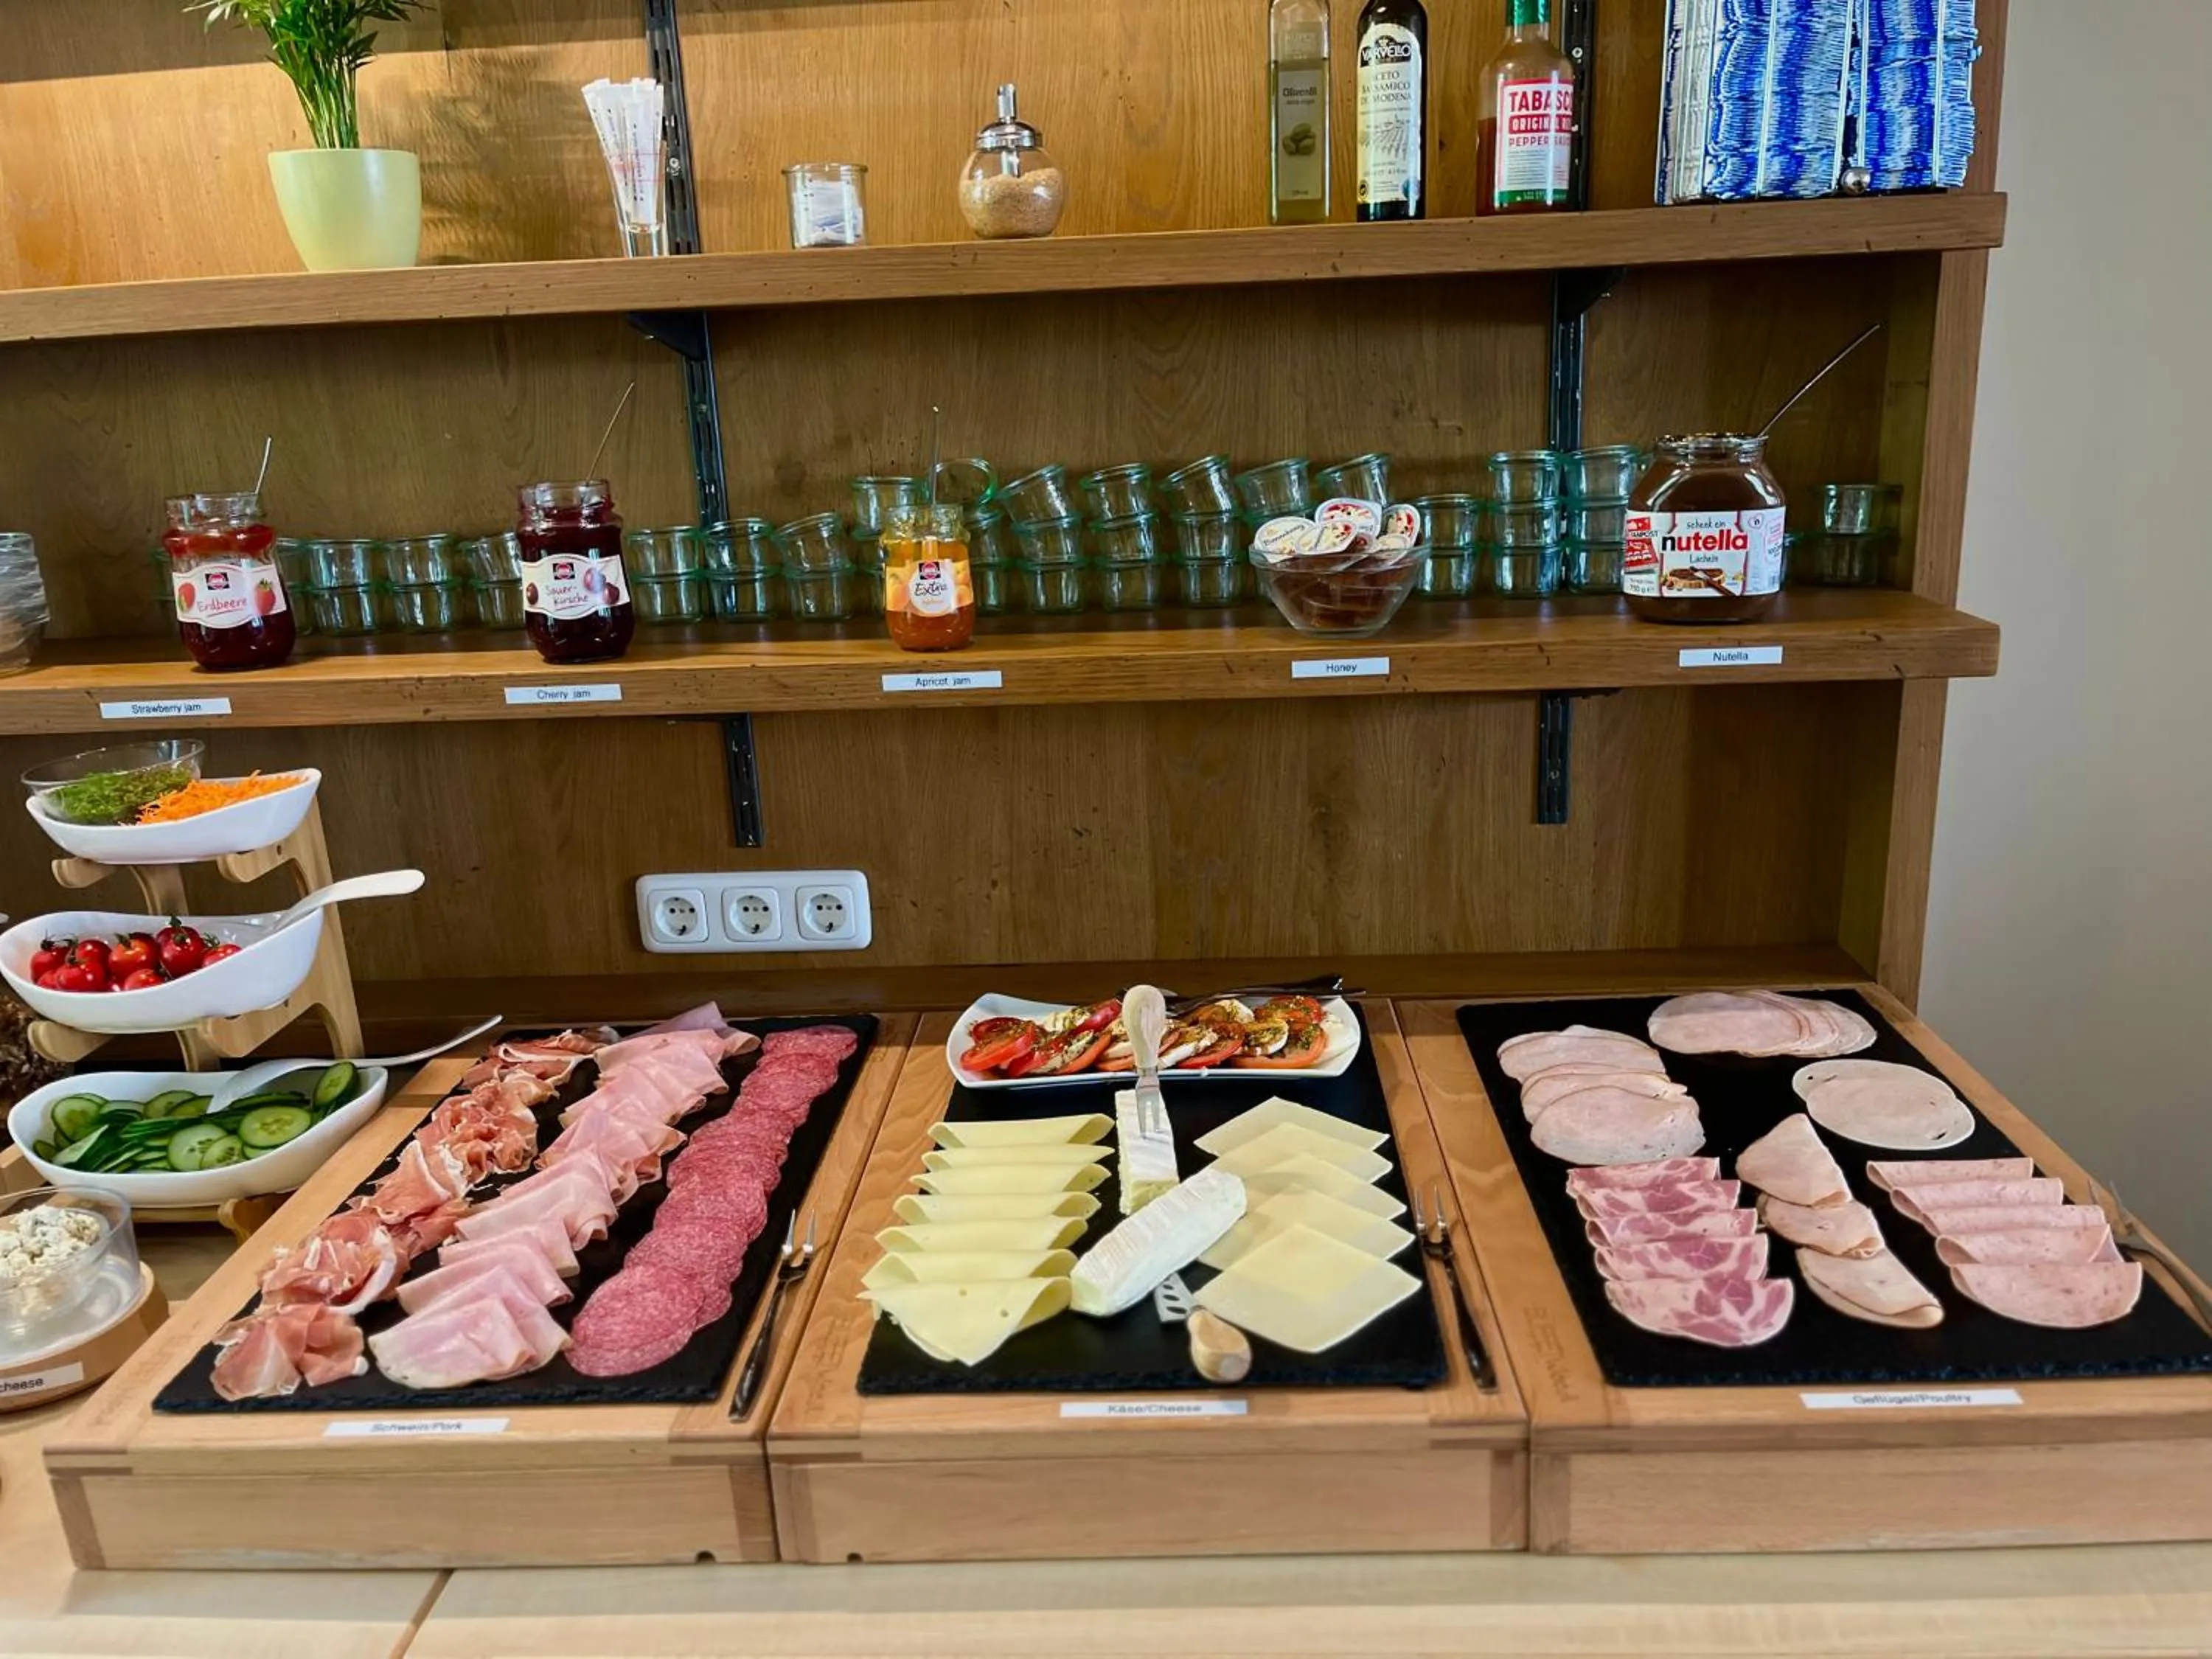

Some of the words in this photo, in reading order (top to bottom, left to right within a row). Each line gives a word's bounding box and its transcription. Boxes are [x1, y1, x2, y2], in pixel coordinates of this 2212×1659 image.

[1362, 44, 1411, 61] VRVELLO
[1512, 116, 1559, 131] ORIGINL
[1662, 529, 1748, 551] nutella
[914, 581, 948, 597] Extra
[196, 596, 248, 613] Erdbeere
[1713, 651, 1749, 661] Nutella
[1326, 663, 1357, 673] Honey
[915, 677, 949, 687] Apricot
[953, 676, 971, 686] jam
[537, 689, 568, 700] Cherry
[573, 689, 591, 698] jam
[131, 703, 182, 714] Strawberry
[185, 703, 202, 713] jam
